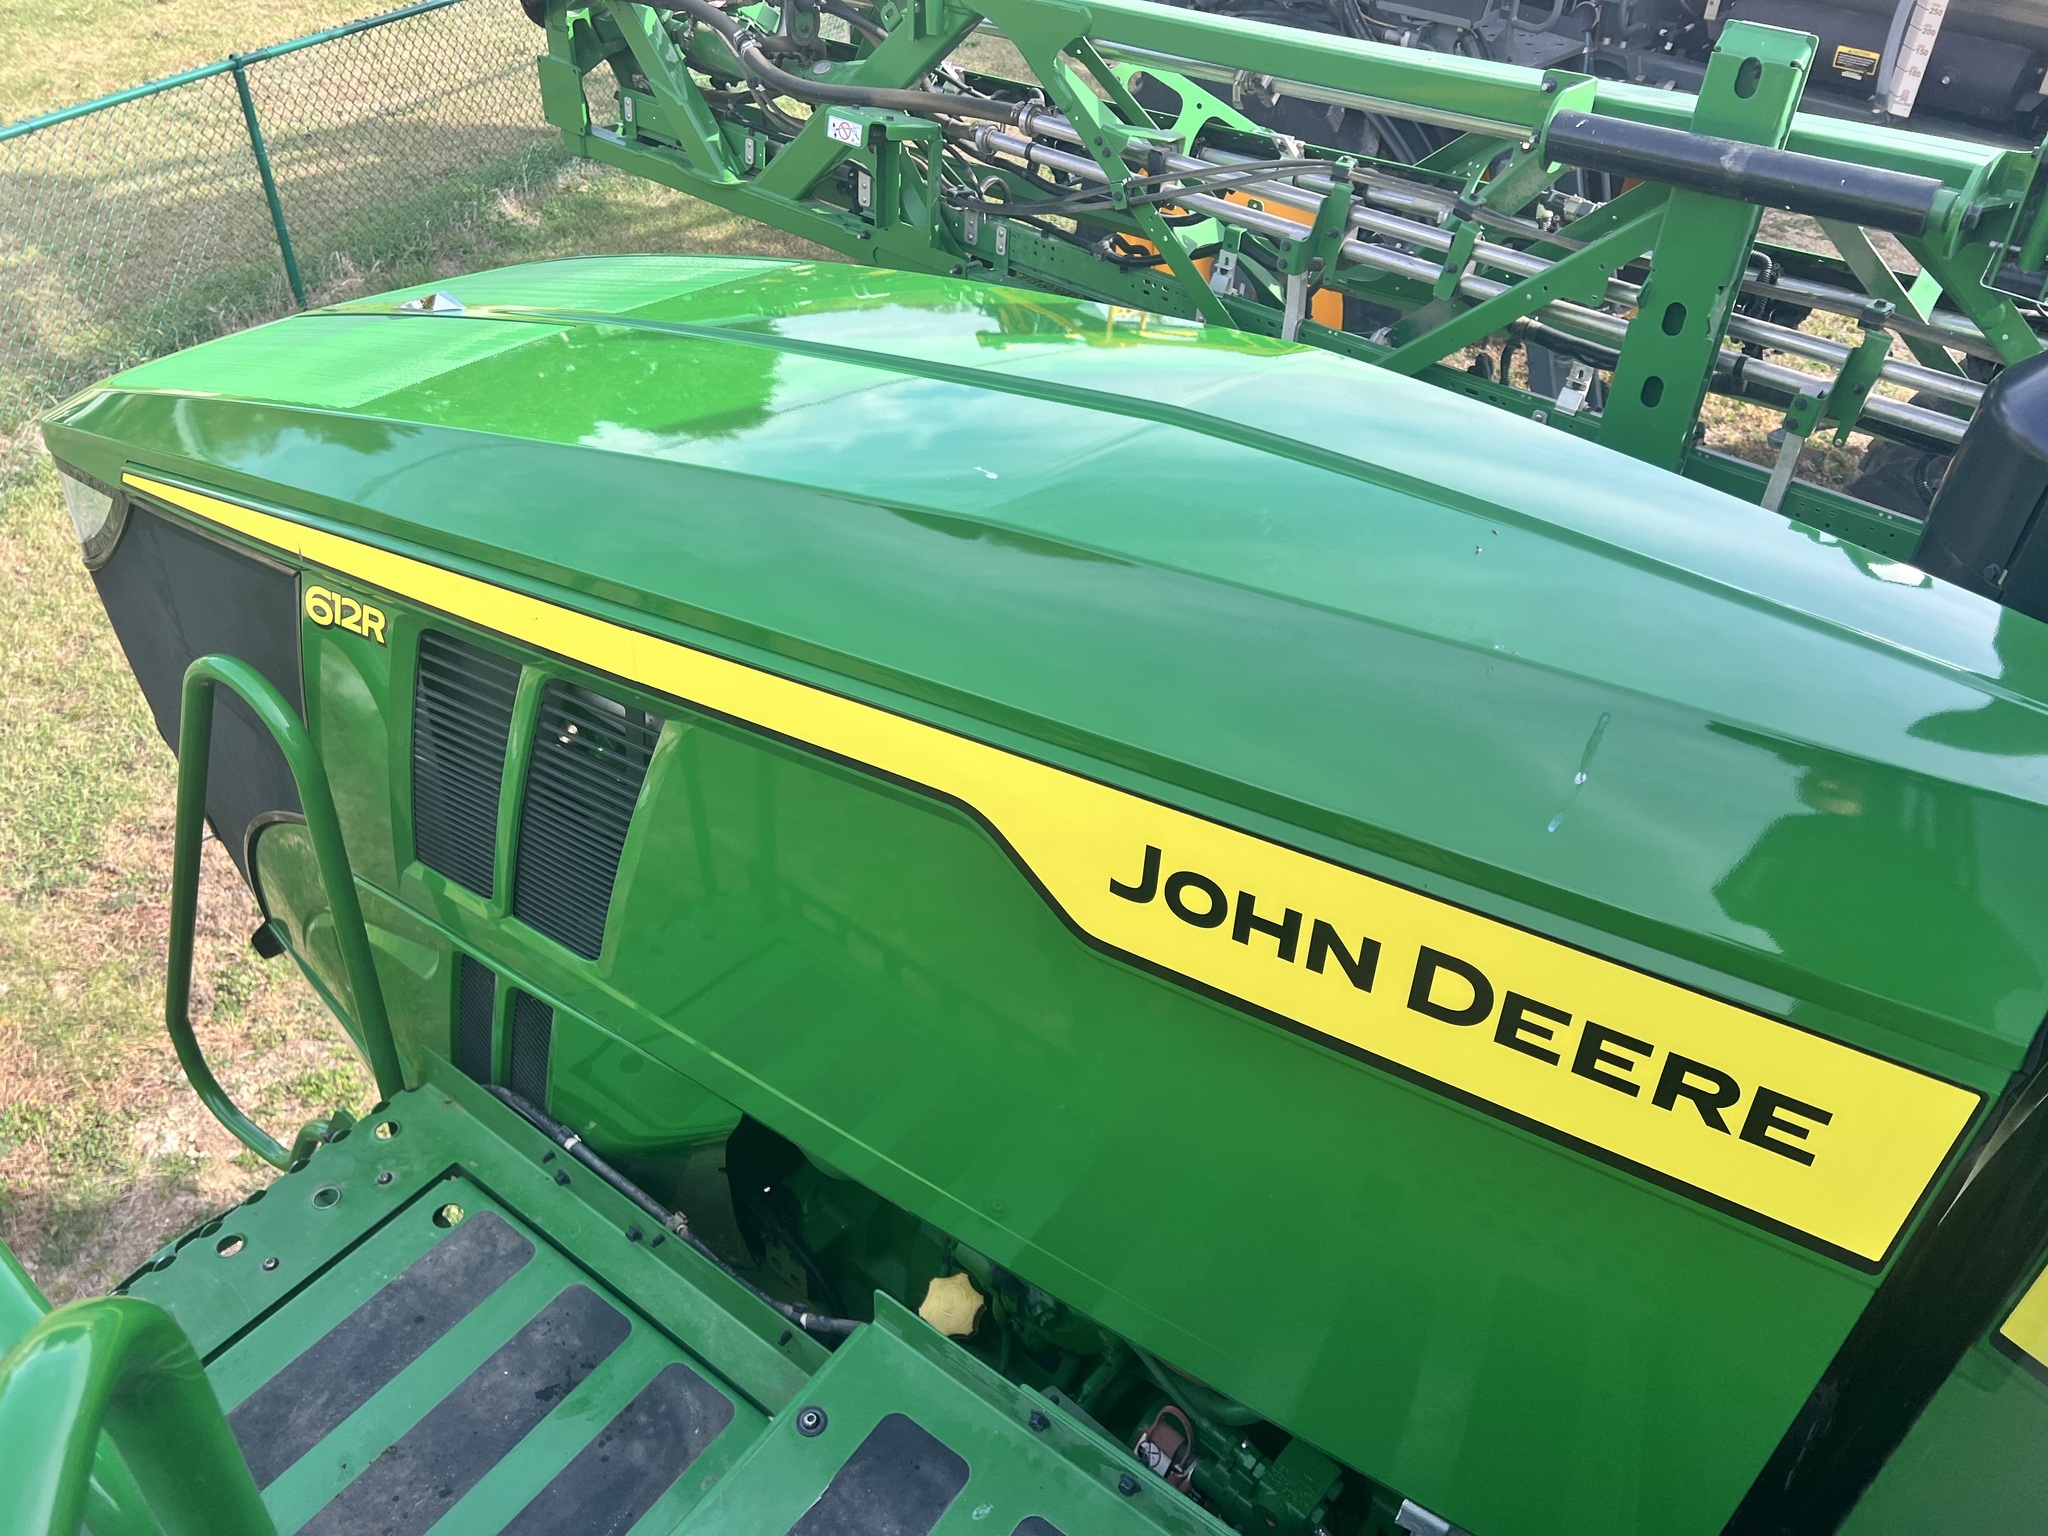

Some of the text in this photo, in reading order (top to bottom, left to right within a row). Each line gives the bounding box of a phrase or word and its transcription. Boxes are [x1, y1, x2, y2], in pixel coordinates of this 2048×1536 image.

[1929, 7, 1943, 16] 250
[1922, 28, 1936, 36] 200
[1916, 47, 1929, 56] 150
[1909, 69, 1921, 78] 100
[304, 584, 386, 646] 612R
[1109, 844, 1833, 1168] JOHN DEERE
